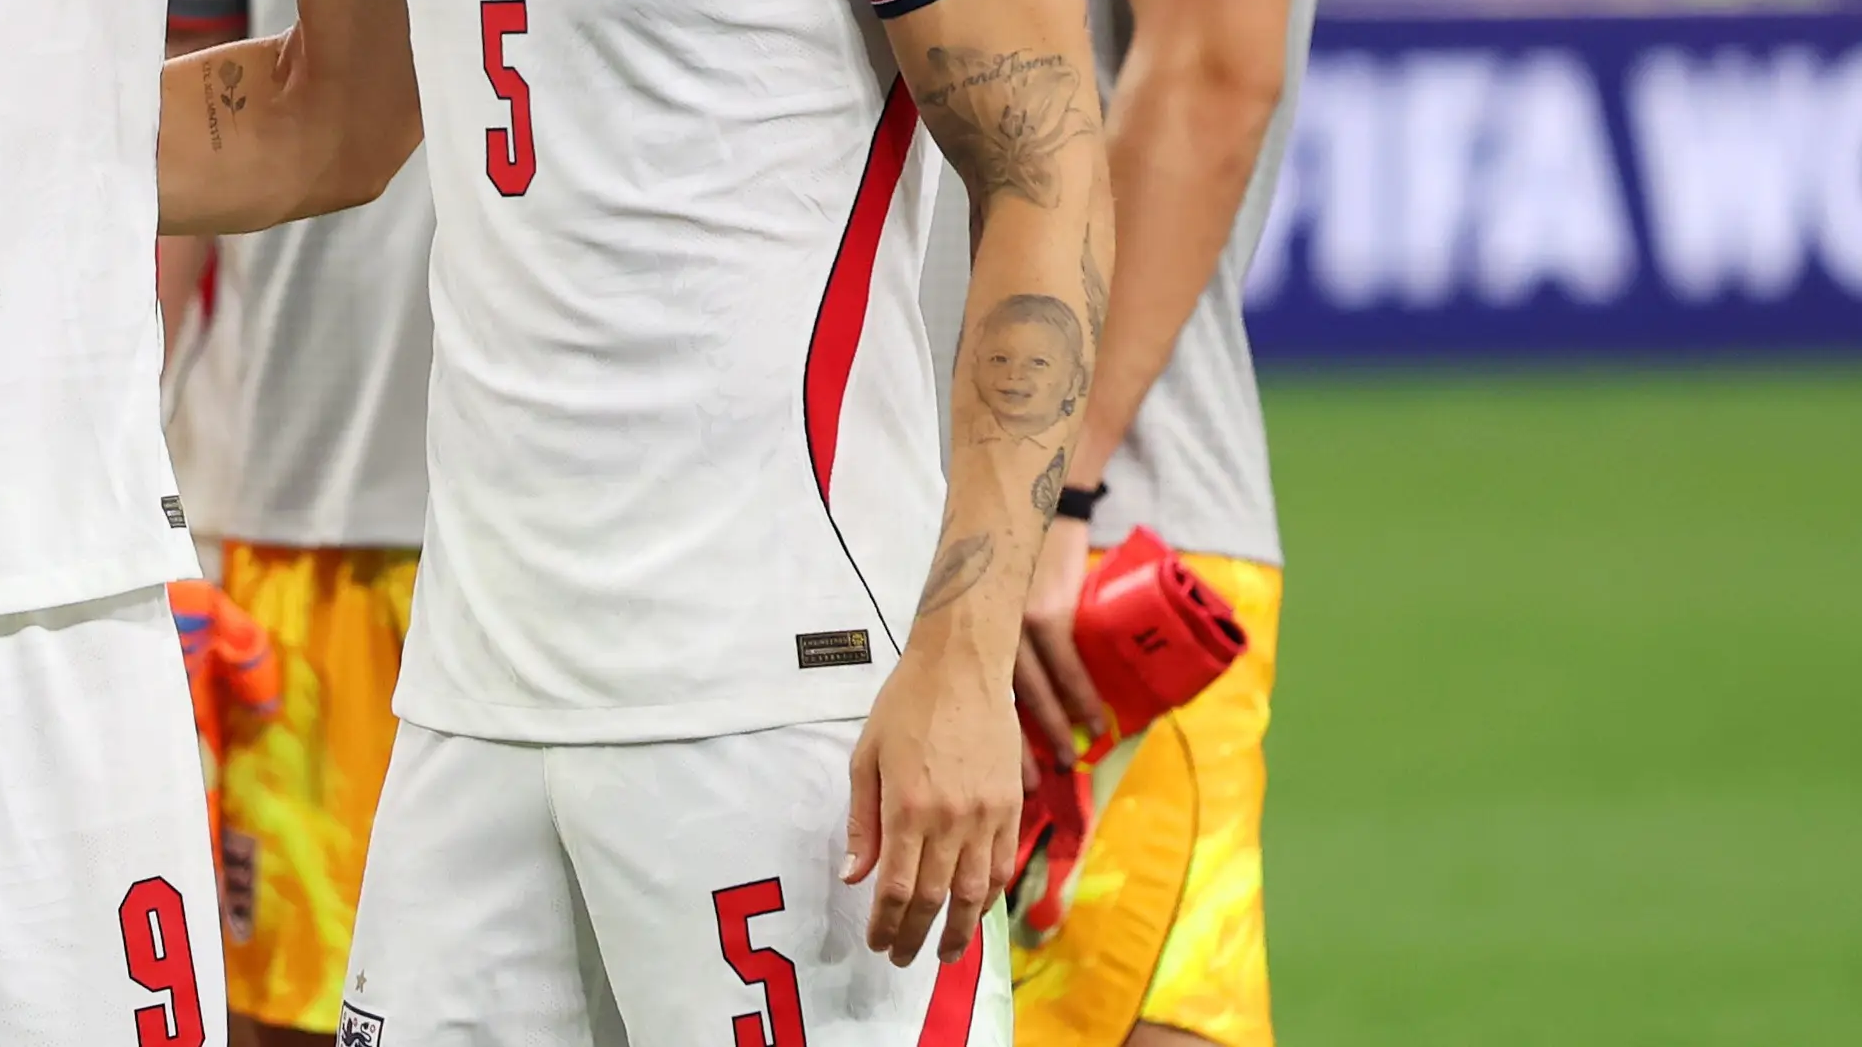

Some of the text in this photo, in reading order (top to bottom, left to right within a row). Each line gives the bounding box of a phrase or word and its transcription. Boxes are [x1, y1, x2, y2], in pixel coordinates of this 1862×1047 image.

[480, 0, 537, 197] 5
[118, 875, 206, 1047] 9
[711, 876, 808, 1047] 5
